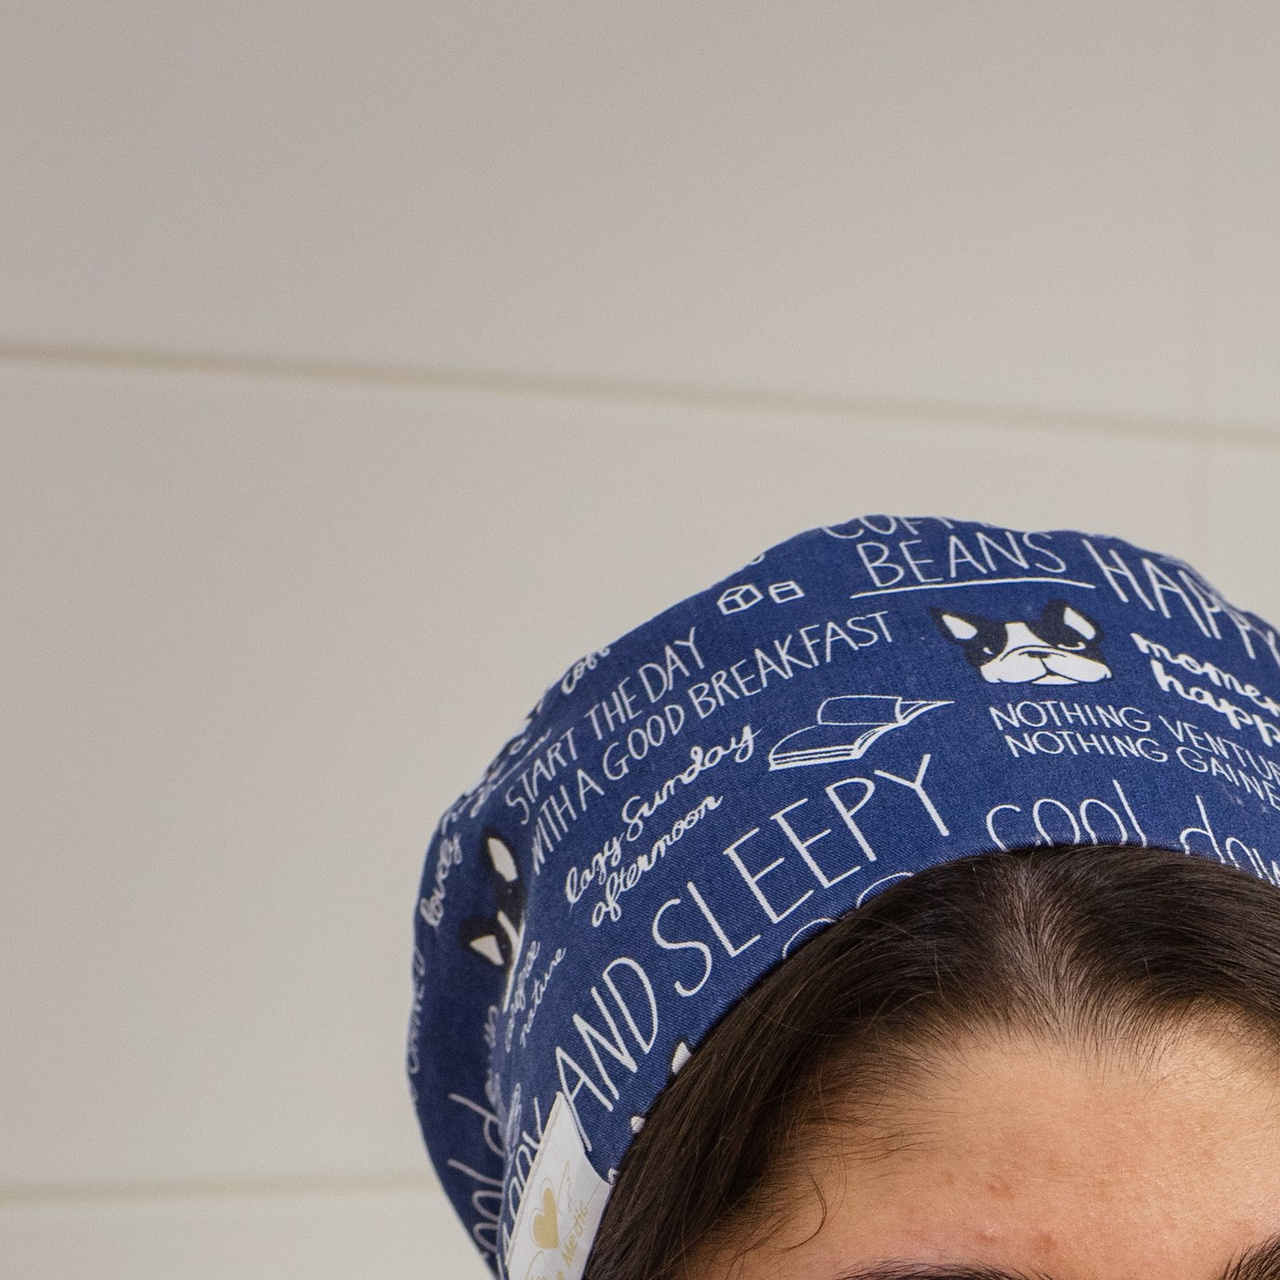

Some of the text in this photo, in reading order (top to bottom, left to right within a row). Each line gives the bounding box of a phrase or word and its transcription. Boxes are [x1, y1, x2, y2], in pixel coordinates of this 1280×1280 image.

[856, 531, 1066, 588] BEANS
[505, 727, 575, 825] START
[584, 677, 643, 740] THE
[638, 627, 706, 703] DAY
[576, 768, 605, 812] A
[603, 704, 685, 780] GOOD
[687, 611, 892, 719] BREAKFAST
[989, 700, 1151, 733] NOTHING
[1004, 730, 1168, 763] NOTHING
[565, 832, 624, 906] lazy
[591, 795, 723, 928] afternoon
[555, 957, 658, 1152] AND
[651, 754, 949, 997] SLEEPY
